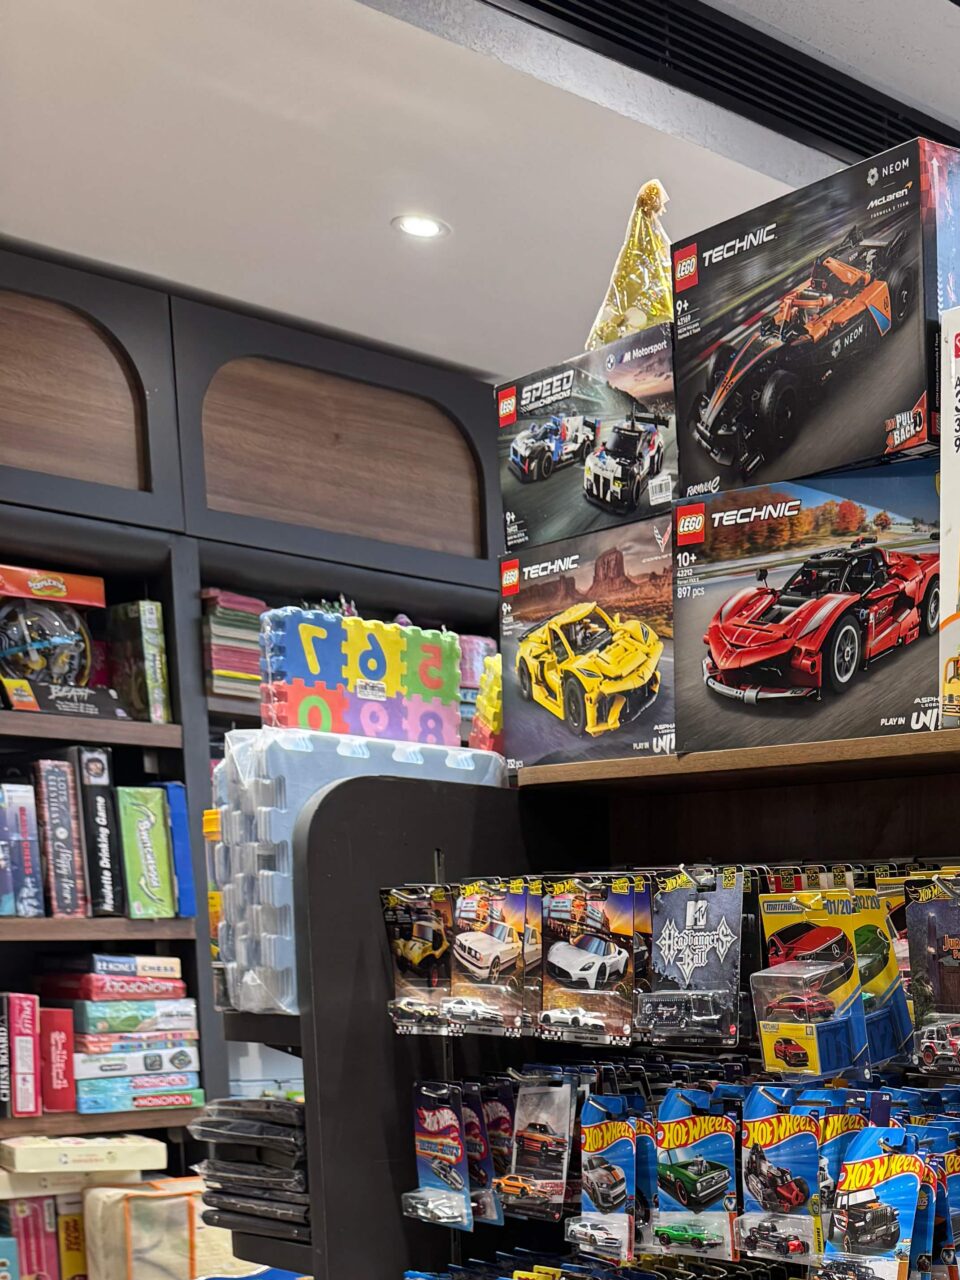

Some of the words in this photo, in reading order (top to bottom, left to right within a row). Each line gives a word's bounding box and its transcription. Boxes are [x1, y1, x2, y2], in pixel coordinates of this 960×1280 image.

[882, 158, 909, 177] NEOM
[867, 187, 908, 210] McLaren
[702, 224, 777, 266] TECHNIC
[676, 255, 697, 279] LEGO
[676, 301, 689, 315] 9+
[844, 324, 864, 348] NEOM
[632, 340, 667, 360] Motorsport
[521, 370, 574, 404] SPEED
[500, 399, 515, 415] LEGO
[895, 410, 914, 425] PULL
[893, 423, 915, 445] BACK
[505, 511, 515, 525] 9+
[679, 514, 704, 531] LEGO
[711, 500, 801, 528] TECHNIC
[522, 555, 579, 580] TECHNIC
[676, 553, 697, 567] 10+
[503, 569, 518, 586] LEGO
[677, 586, 691, 598] 897
[693, 586, 704, 597] pcs
[502, 603, 512, 615] 9+
[95, 796, 107, 826] Game
[827, 900, 851, 914] 01/20
[137, 1095, 192, 1107] MONOPOLY
